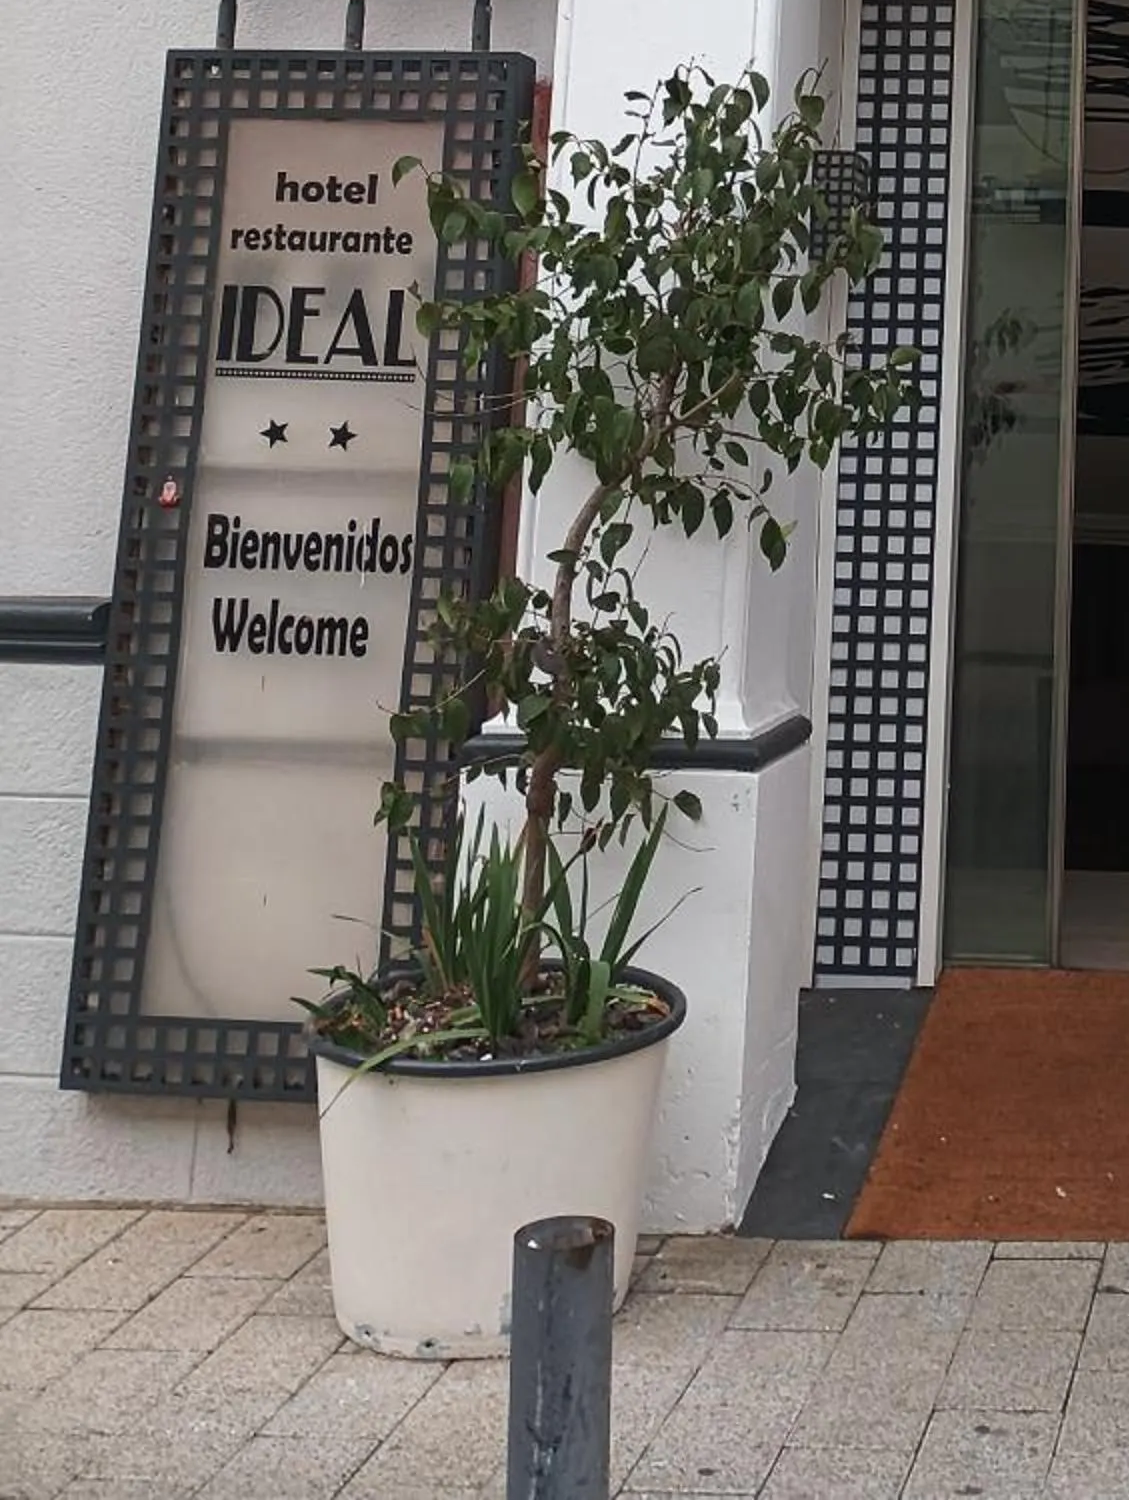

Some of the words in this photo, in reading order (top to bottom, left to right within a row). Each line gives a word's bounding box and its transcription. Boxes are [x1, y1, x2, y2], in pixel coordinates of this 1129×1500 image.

[275, 171, 379, 205] hotel
[230, 225, 413, 255] restaurante
[216, 284, 417, 367] IDEAL
[204, 513, 413, 575] Bienvenidos
[212, 597, 369, 657] Welcome
